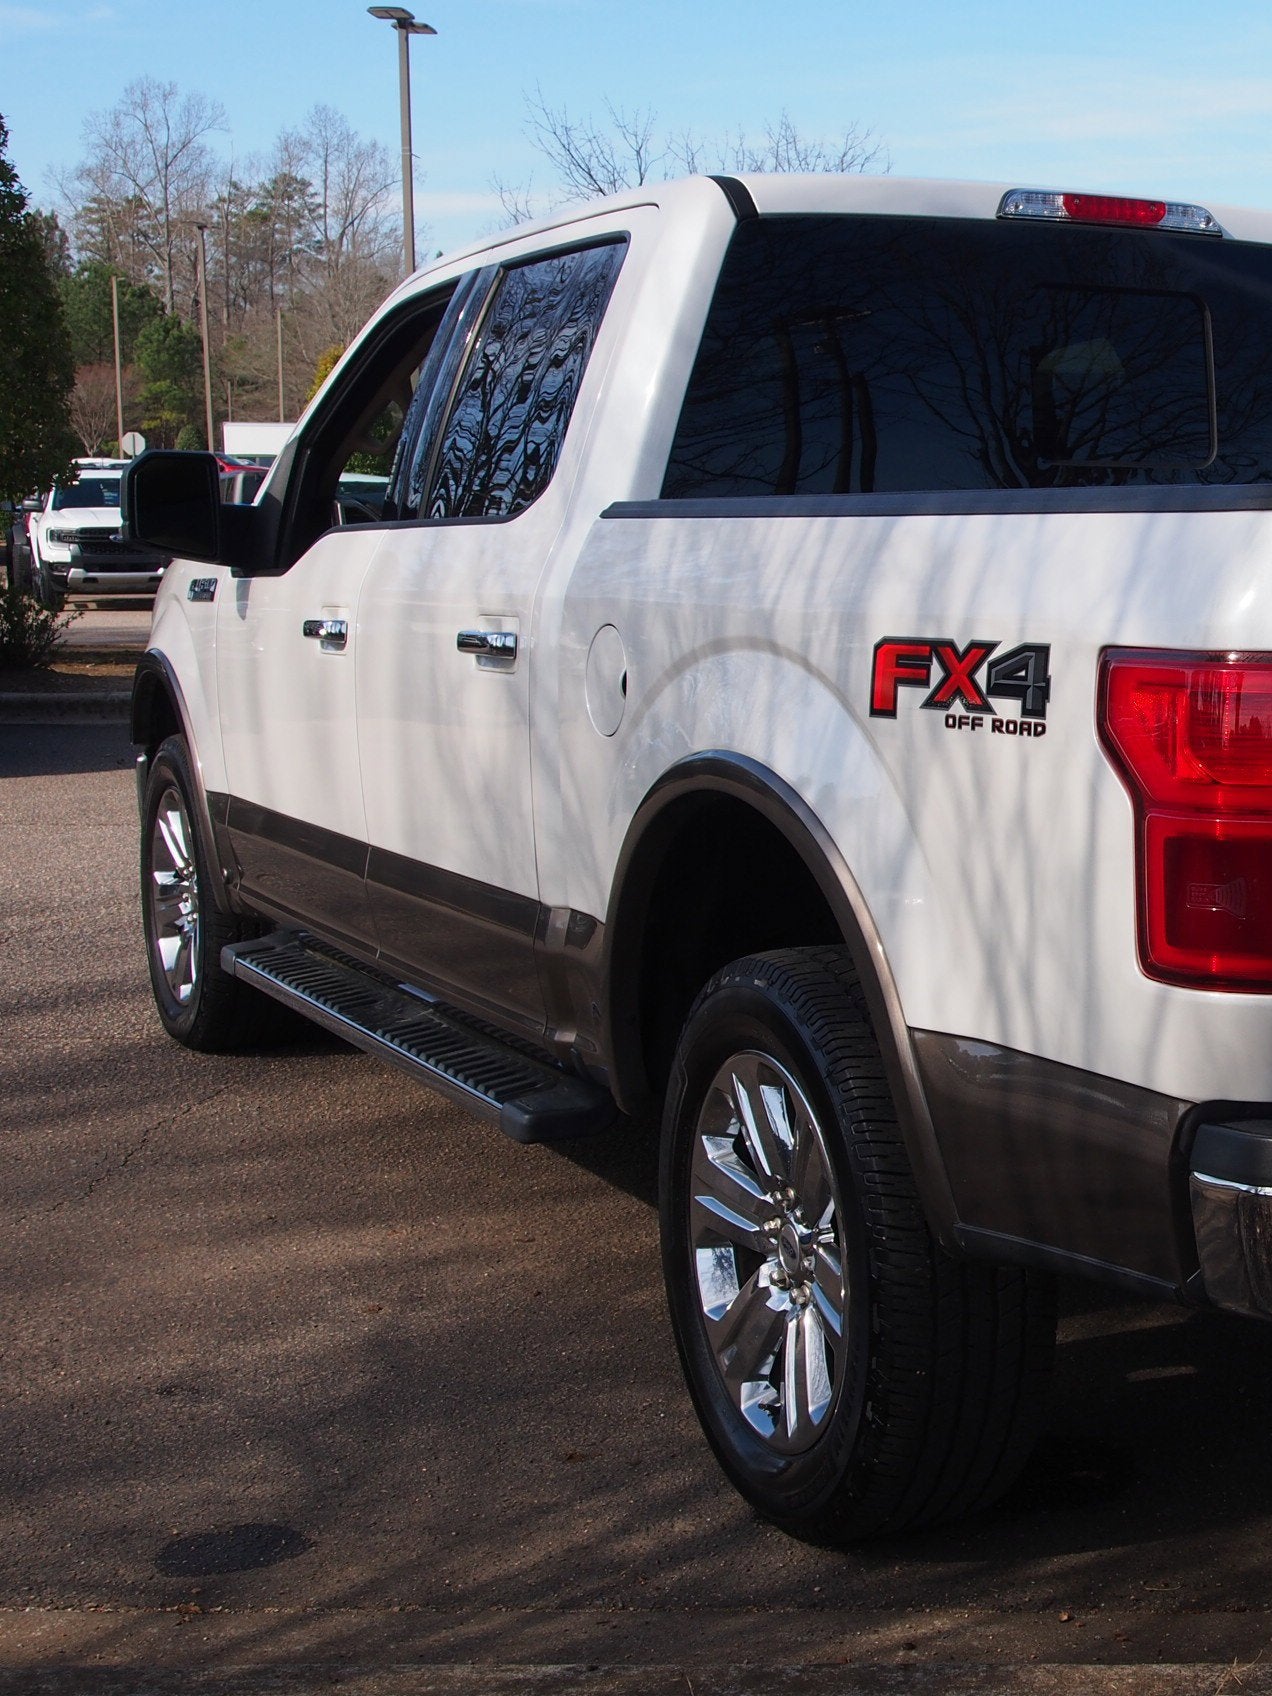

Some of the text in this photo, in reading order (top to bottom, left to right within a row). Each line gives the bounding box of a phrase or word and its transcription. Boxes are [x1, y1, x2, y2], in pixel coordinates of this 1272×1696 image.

[869, 636, 1051, 719] FX4
[945, 714, 1046, 737] OFF ROAD
